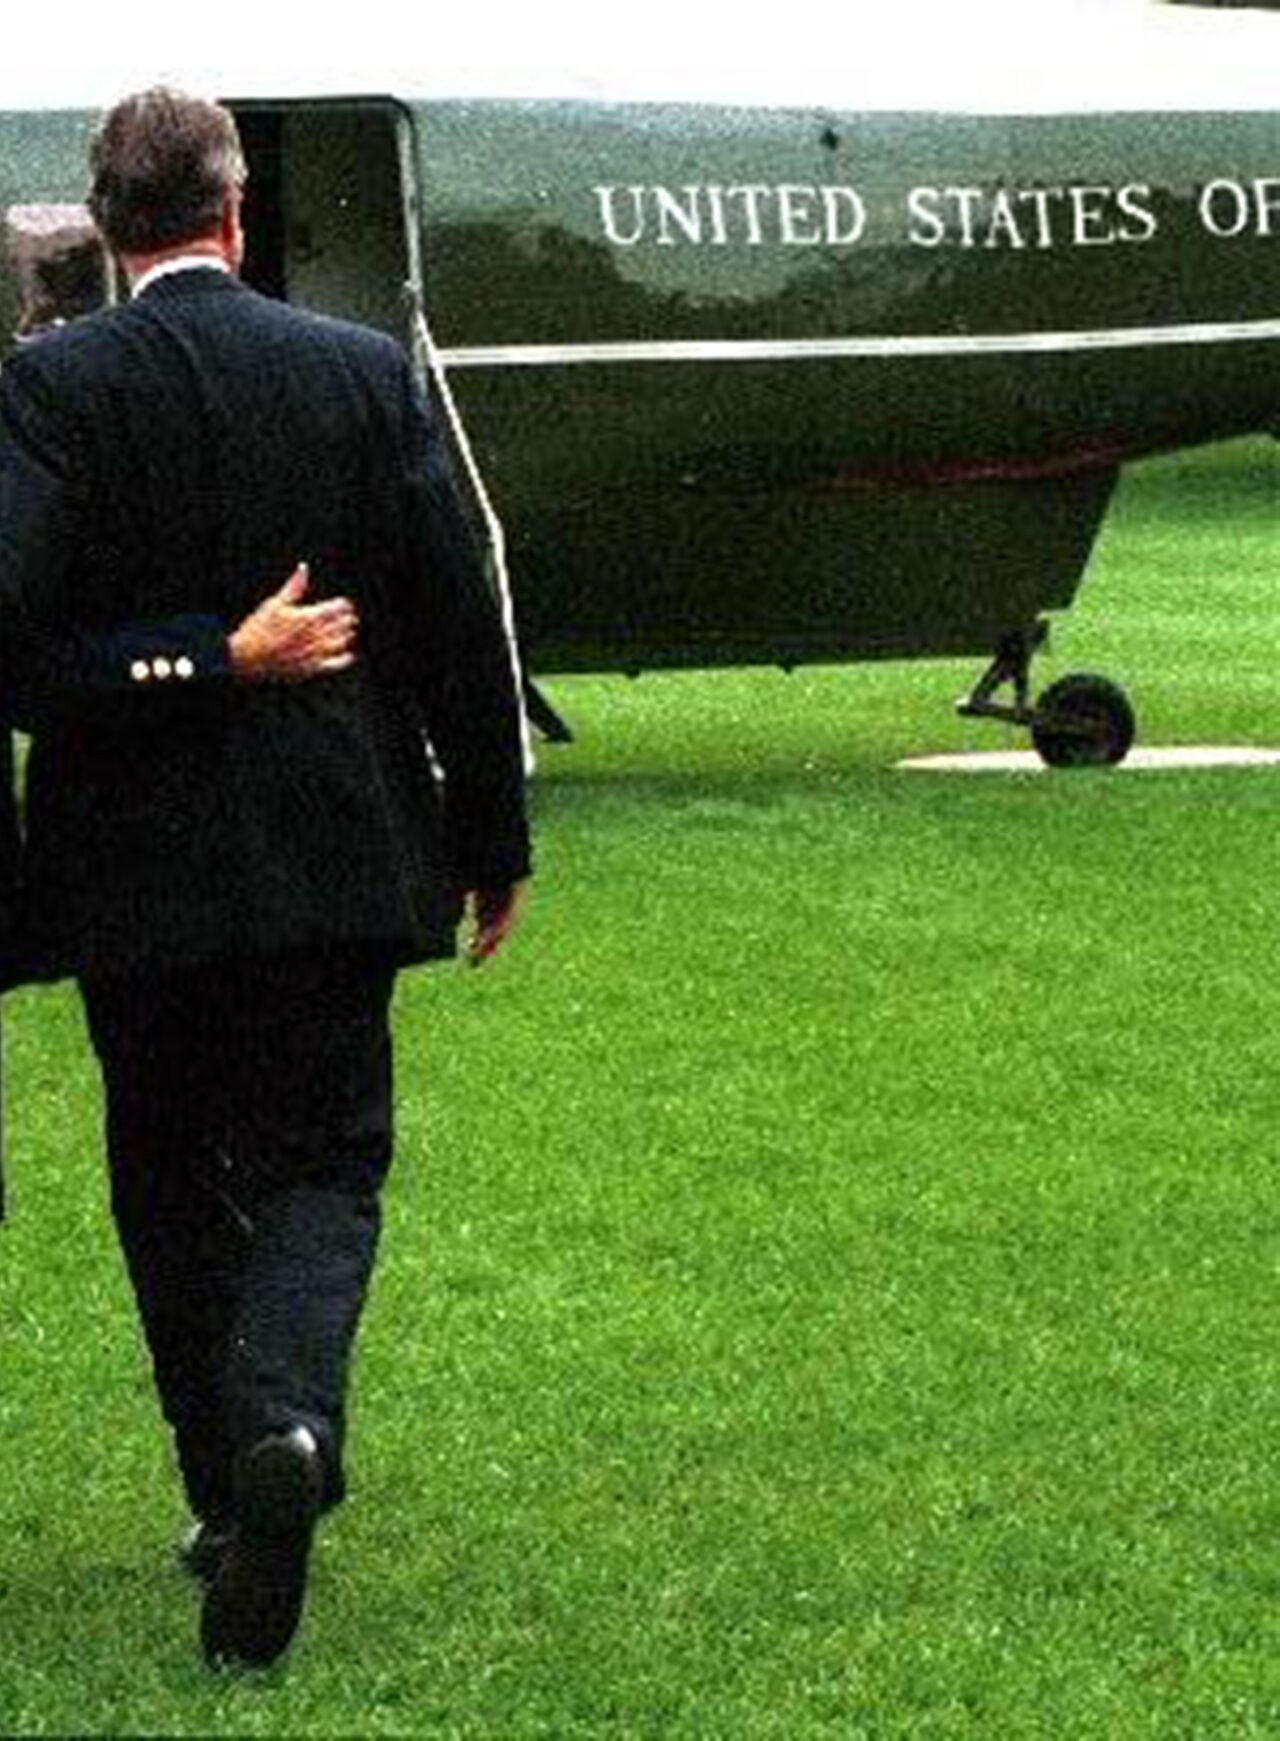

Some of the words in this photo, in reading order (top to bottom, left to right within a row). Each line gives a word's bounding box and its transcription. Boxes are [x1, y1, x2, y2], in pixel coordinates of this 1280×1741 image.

[592, 184, 867, 245] UNITED
[907, 183, 1158, 248] STATES
[1198, 177, 1280, 237] OF
